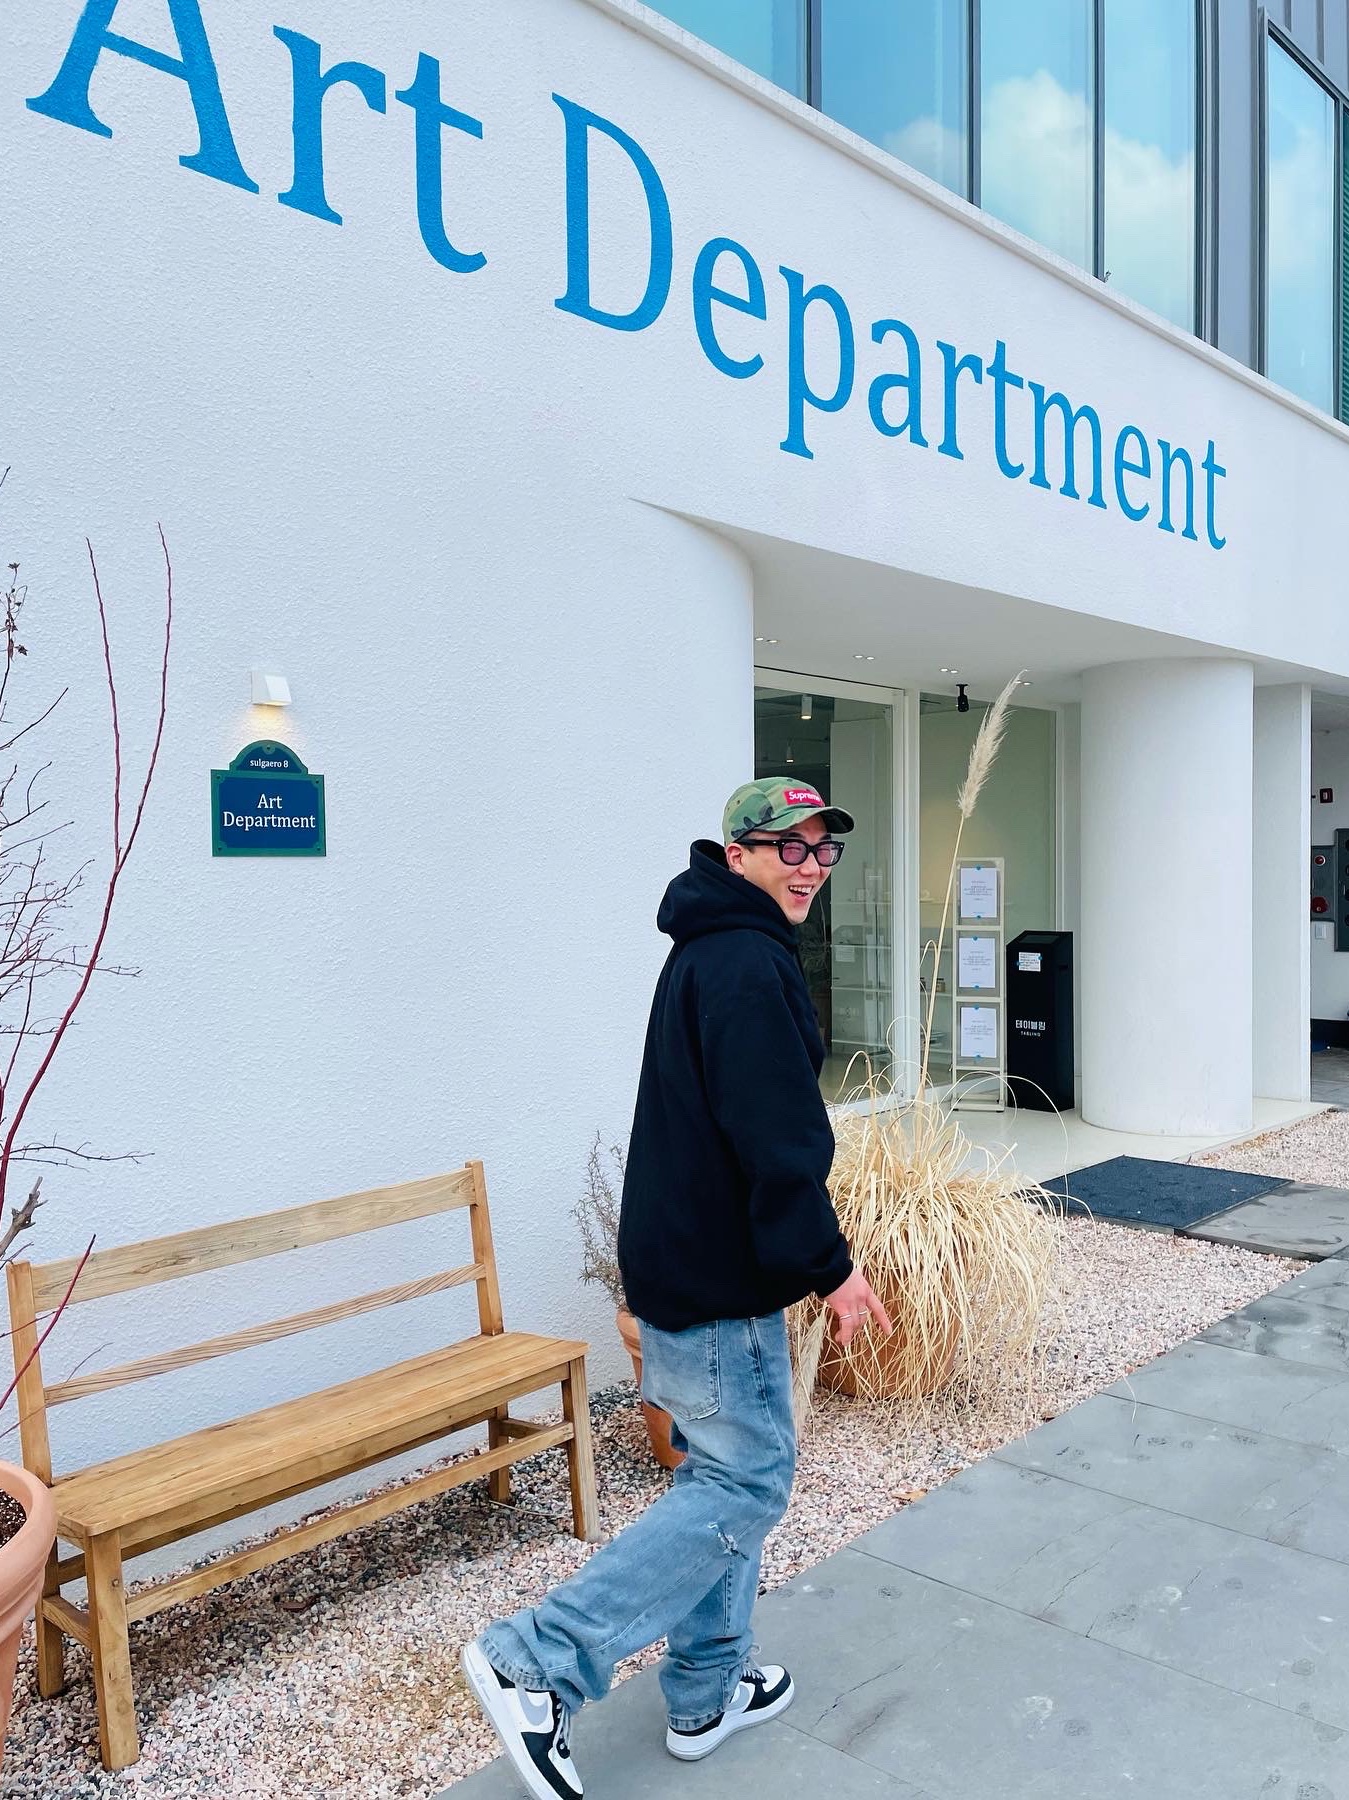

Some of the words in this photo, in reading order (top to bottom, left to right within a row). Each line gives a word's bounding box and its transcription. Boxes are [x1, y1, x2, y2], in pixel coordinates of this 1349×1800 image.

[26, 0, 487, 273] Art
[552, 92, 1227, 550] Department
[249, 758, 282, 769] sulgaero
[283, 760, 289, 768] 8
[257, 793, 283, 809] Art
[788, 791, 821, 802] Suprem
[223, 811, 316, 831] Department
